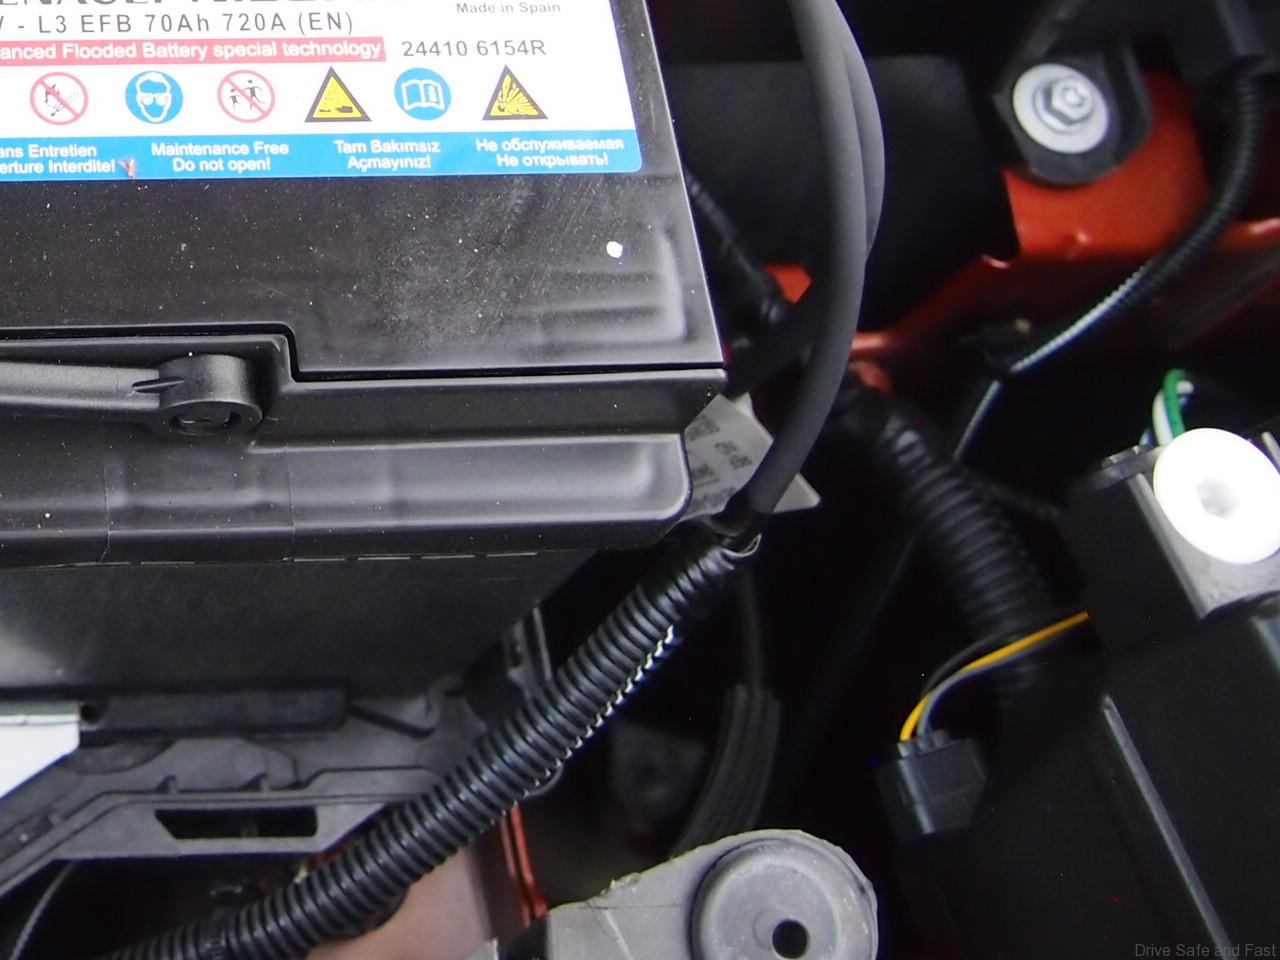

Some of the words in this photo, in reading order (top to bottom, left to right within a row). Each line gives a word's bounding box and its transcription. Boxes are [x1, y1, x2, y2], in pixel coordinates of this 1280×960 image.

[456, 2, 496, 14] Made
[501, 2, 514, 13] in
[519, 2, 561, 16] Spain
[38, 15, 68, 33] L3
[81, 15, 132, 33] EFB
[145, 14, 210, 32] 70Ah
[224, 13, 286, 32] 720A
[298, 11, 354, 35] (EN)
[62, 42, 136, 60] Flooded
[142, 41, 208, 63] Battery
[213, 40, 279, 62] special
[283, 40, 382, 60] technology
[401, 40, 468, 57] 24410
[476, 39, 547, 56] 6154R
[28, 144, 97, 158] Entretien
[151, 142, 248, 156] Maintenance
[252, 142, 290, 156] Free
[334, 139, 367, 153] Tam
[47, 159, 116, 175] Interdite!
[172, 158, 195, 172] Do
[198, 158, 223, 172] not
[226, 158, 271, 175] open!
[523, 153, 609, 169] открывать!
